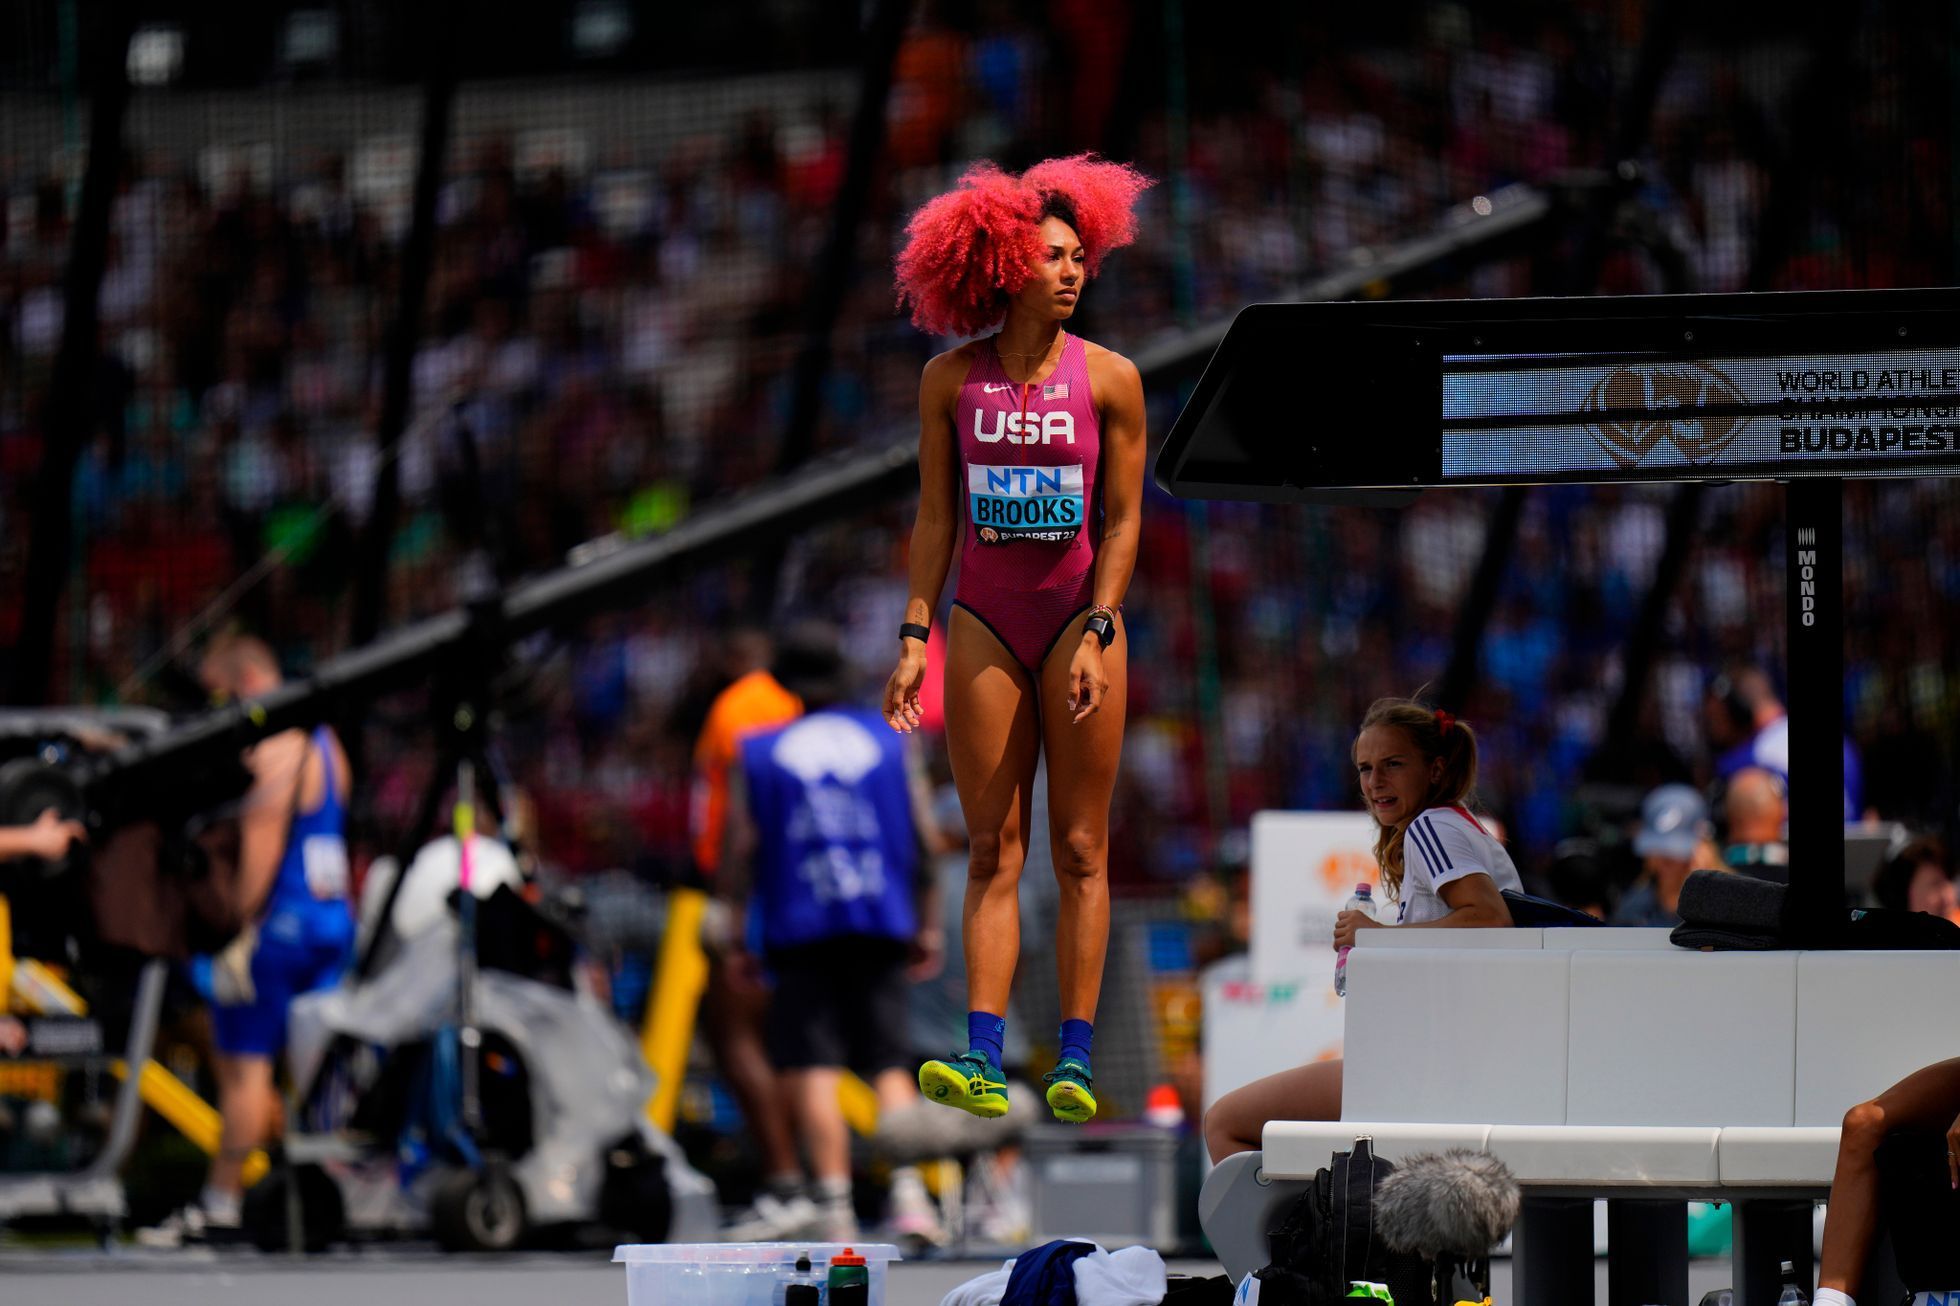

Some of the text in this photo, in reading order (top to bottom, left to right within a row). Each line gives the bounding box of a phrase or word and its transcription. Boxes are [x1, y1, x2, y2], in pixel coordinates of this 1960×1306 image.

[1777, 368, 1960, 392] WORLD ATHLE
[974, 408, 1075, 445] USA
[987, 468, 1061, 495] NTN
[977, 496, 1076, 525] BROOKS
[1798, 550, 1816, 626] MONDO
